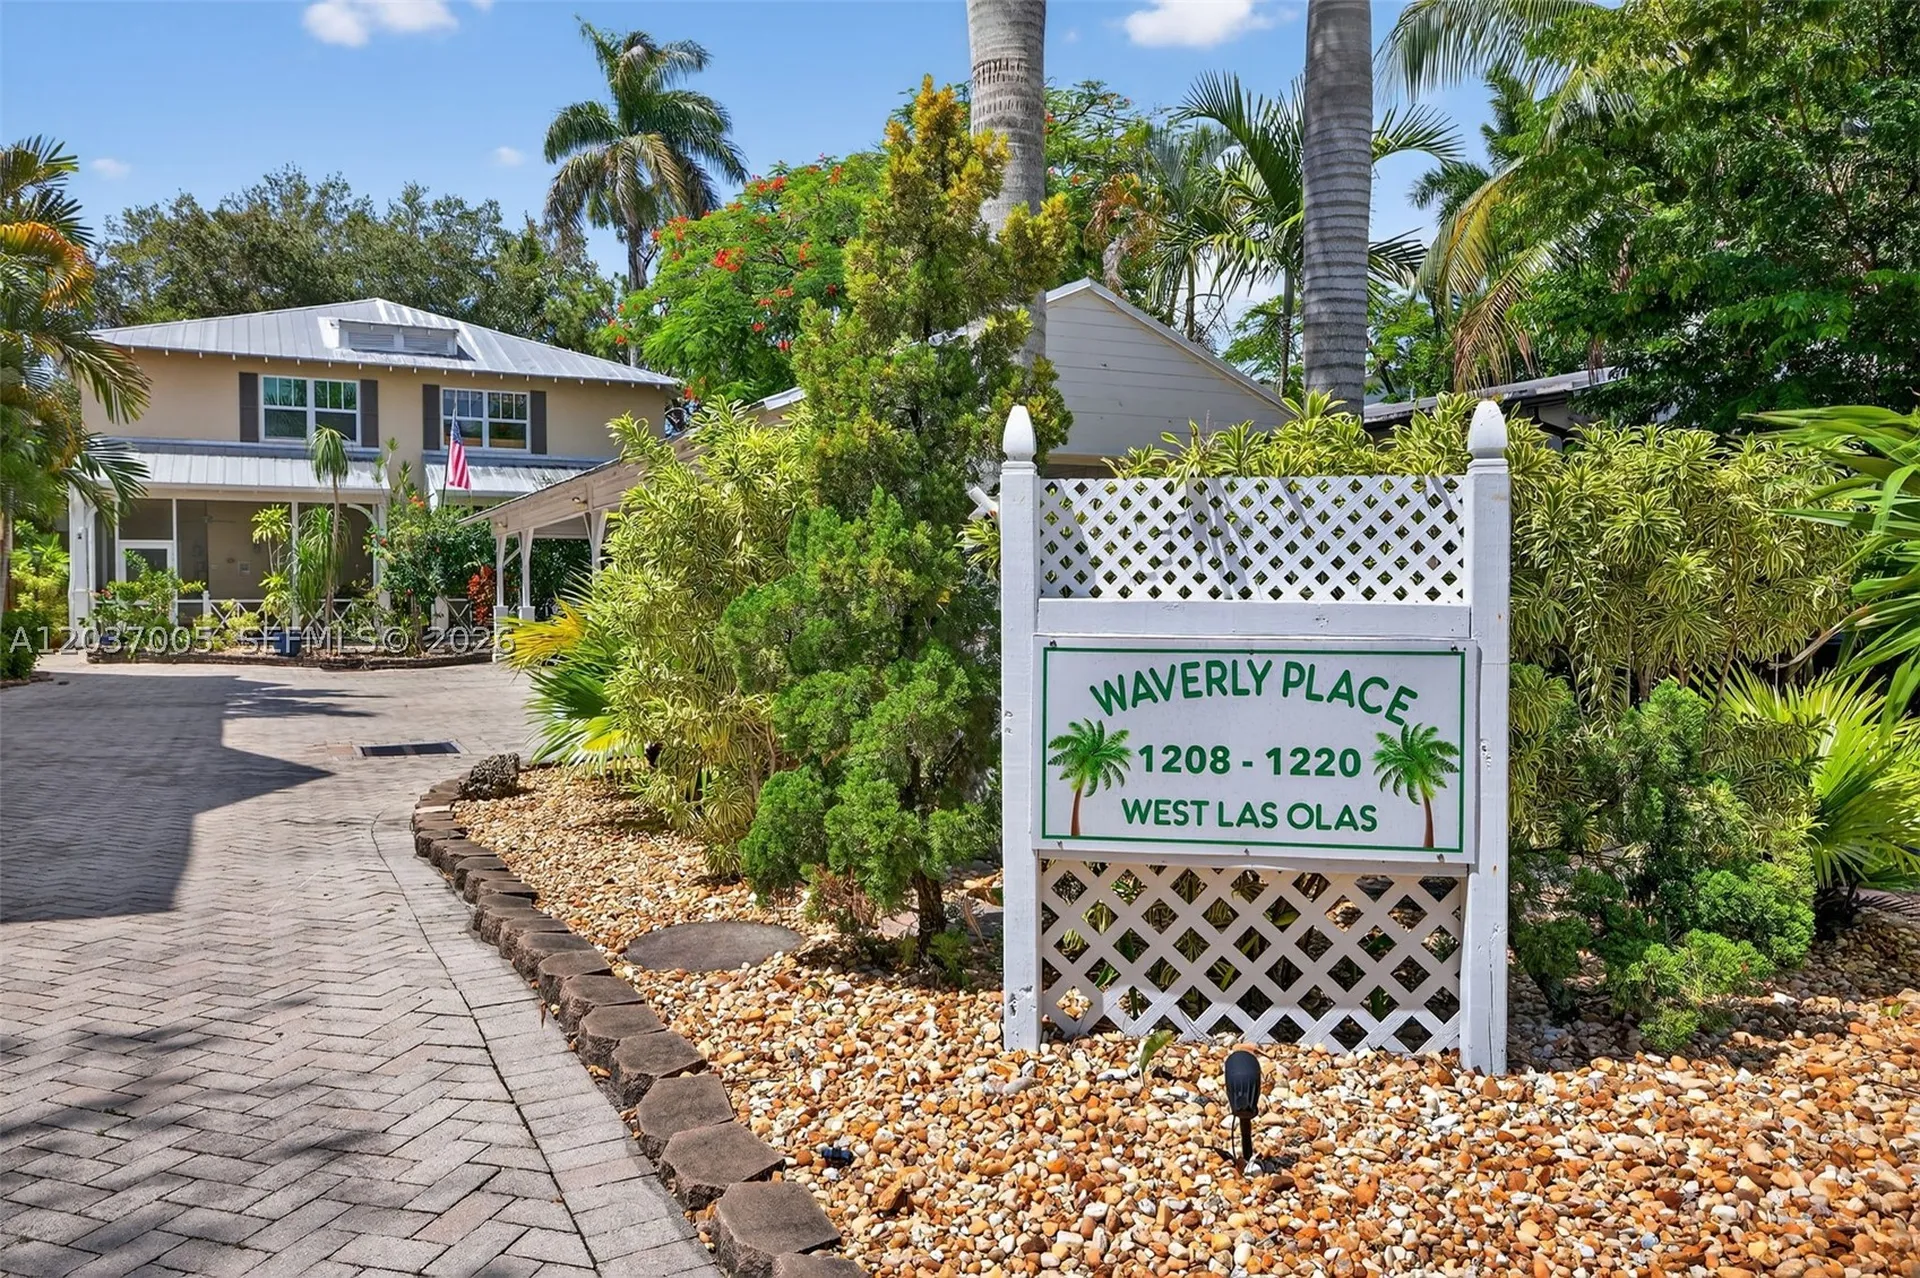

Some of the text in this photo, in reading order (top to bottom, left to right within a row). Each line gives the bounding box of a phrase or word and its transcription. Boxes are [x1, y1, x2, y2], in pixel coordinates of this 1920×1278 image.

[1089, 658, 1419, 726] WAVERLY PLACE
[1138, 744, 1232, 775] 1208
[1265, 746, 1363, 777] 1220
[1121, 797, 1379, 832] WEST LAS OLAS
